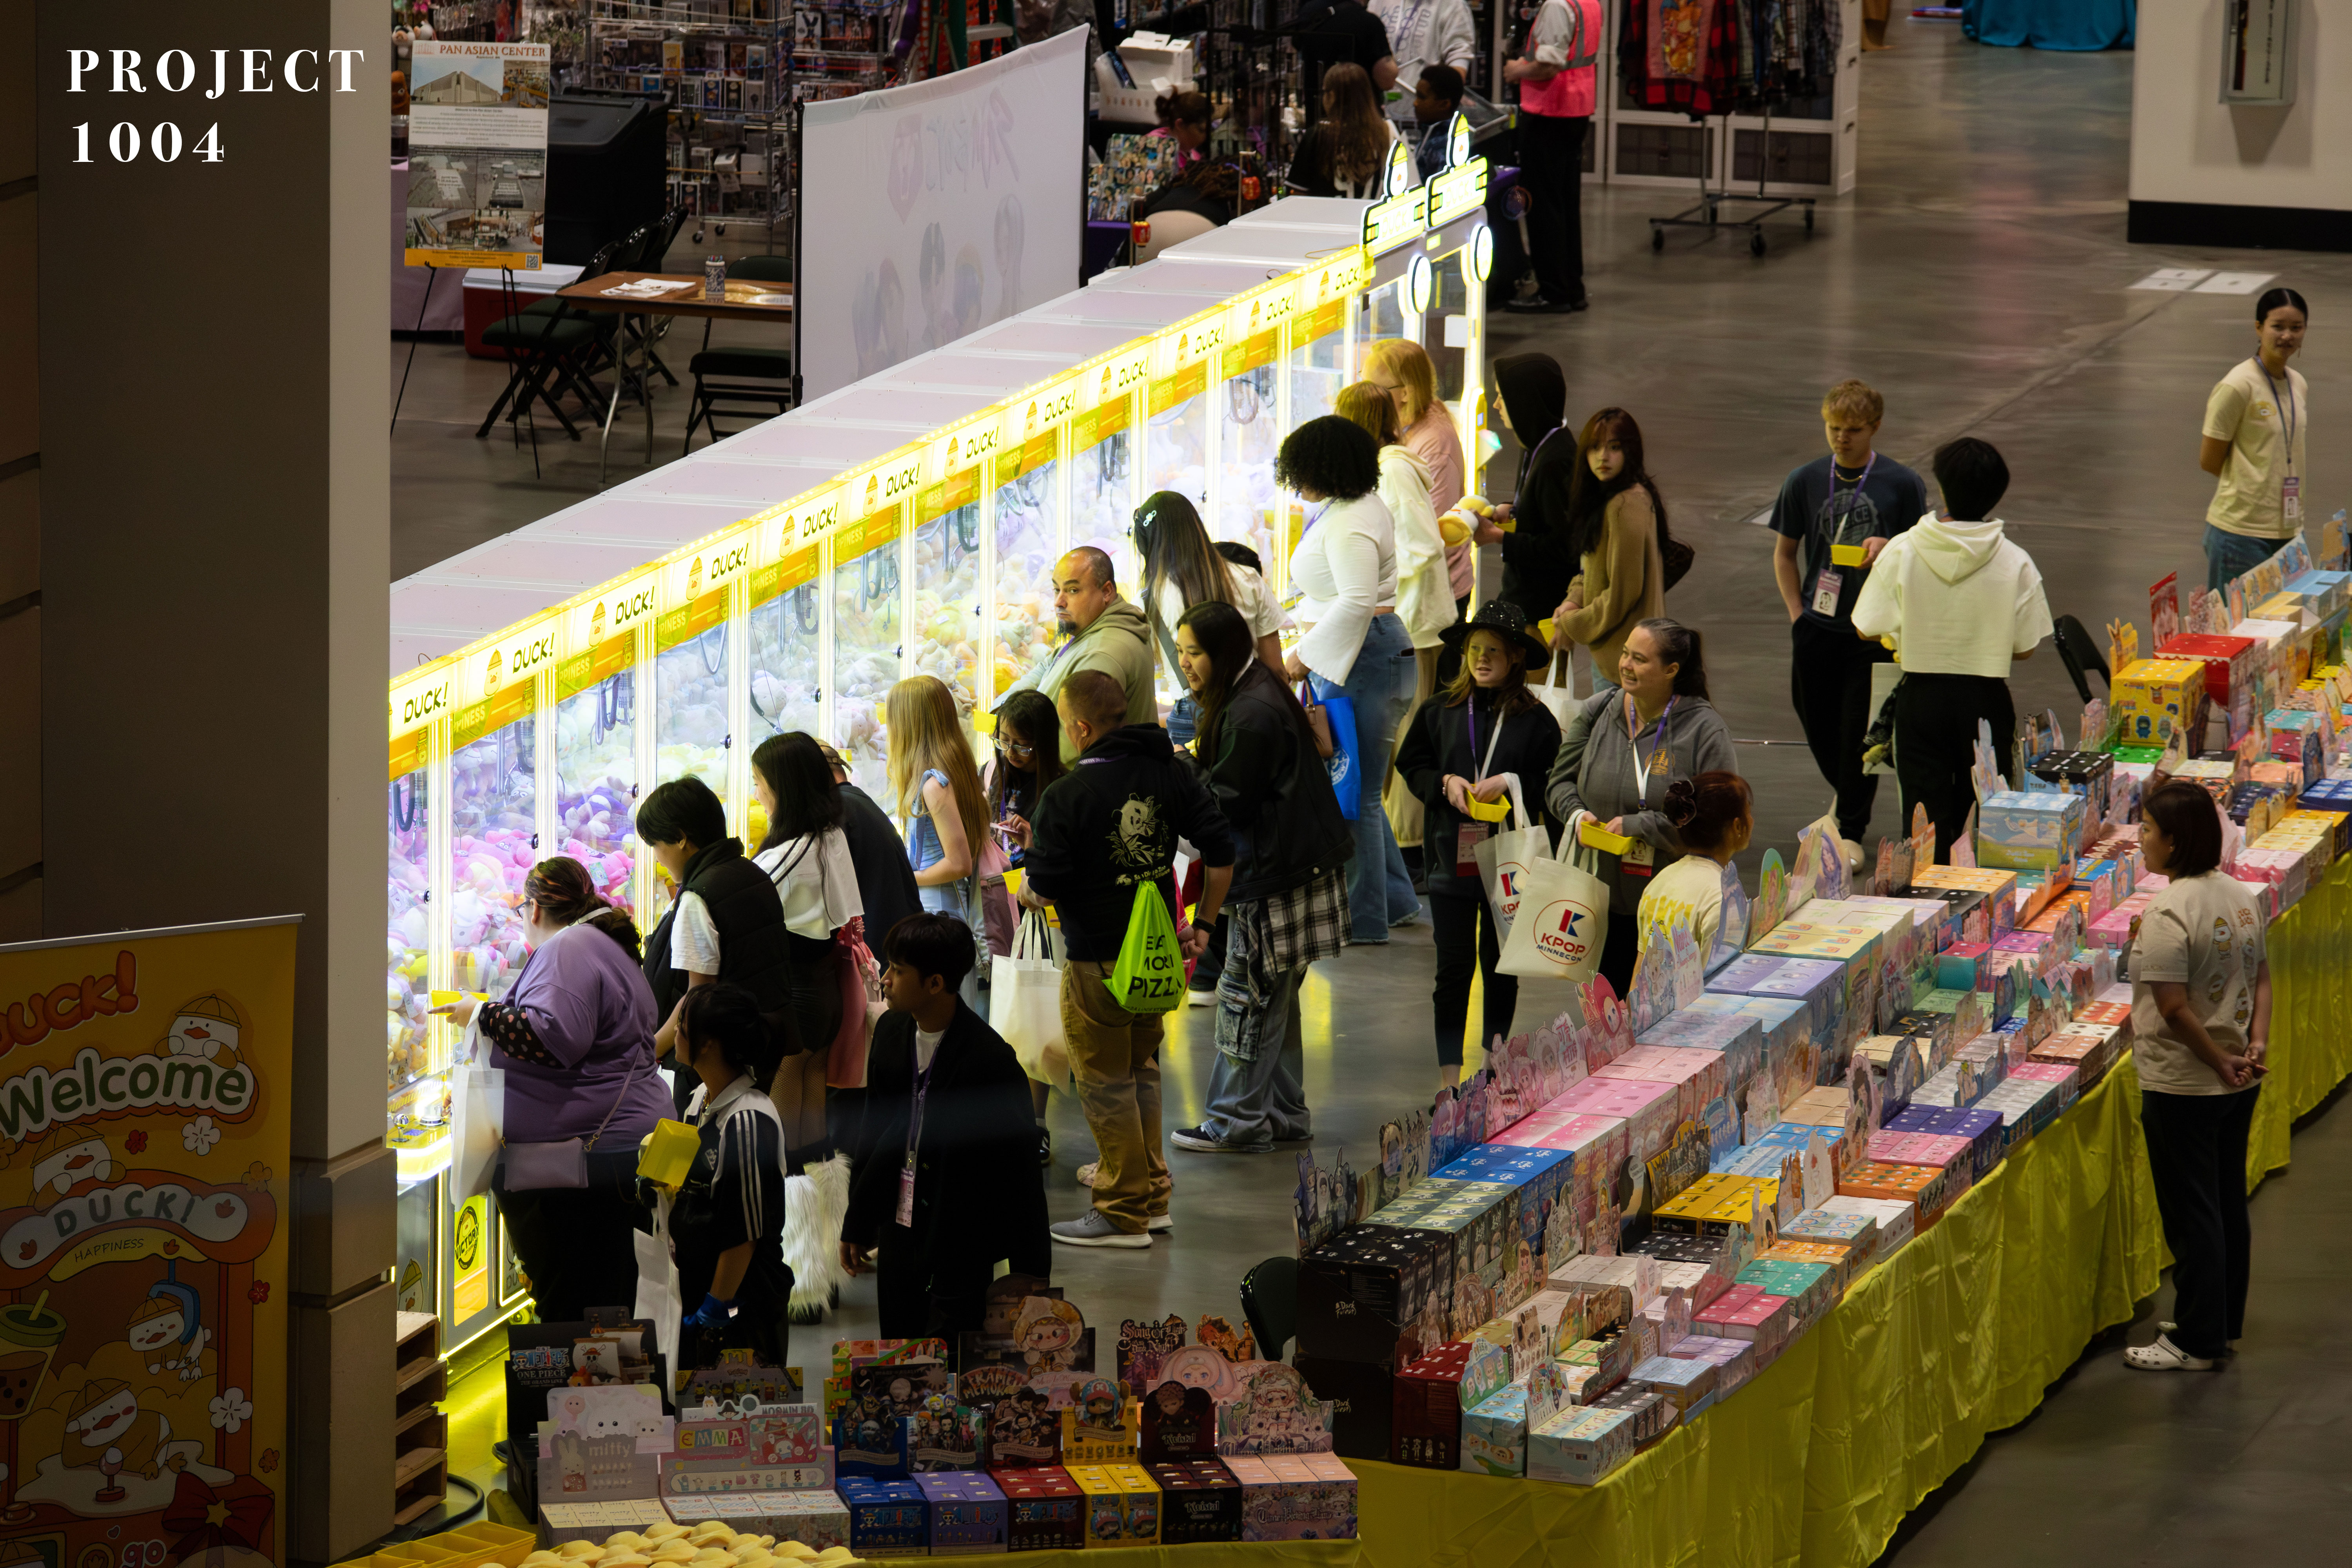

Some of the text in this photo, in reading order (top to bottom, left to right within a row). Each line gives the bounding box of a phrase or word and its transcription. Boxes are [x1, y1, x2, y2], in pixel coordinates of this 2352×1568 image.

[440, 45, 546, 56] PAN ASIAN CENTER
[1336, 263, 1364, 290] DUCK!
[1267, 292, 1296, 320] DUCK!
[1196, 324, 1225, 354] DUCK!
[1119, 356, 1149, 387] DUCK!
[1045, 390, 1076, 421] DUCK!
[967, 426, 999, 459] DUCK!
[886, 463, 920, 497] DUCK!
[803, 502, 837, 537] DUCK!
[711, 543, 748, 580] DUCK!
[615, 586, 654, 625] DUCK!
[513, 633, 554, 673] DUCK!
[404, 682, 448, 724] DUCK!
[1146, 935, 1165, 950] EA
[1536, 944, 1583, 962] MINNECON
[1541, 933, 1586, 955] KPOP
[0, 1056, 247, 1135] Welcome
[54, 1190, 196, 1237] DUCK!
[75, 1238, 144, 1262] HAPPINESS
[455, 1222, 479, 1260] VICTORY
[1339, 1301, 1355, 1310] Dark
[1122, 1321, 1151, 1340] Song
[517, 1369, 566, 1379] ONE PIECE
[588, 1441, 631, 1457] miffy
[681, 1427, 744, 1447] EMMA
[122, 1540, 166, 1568] go
